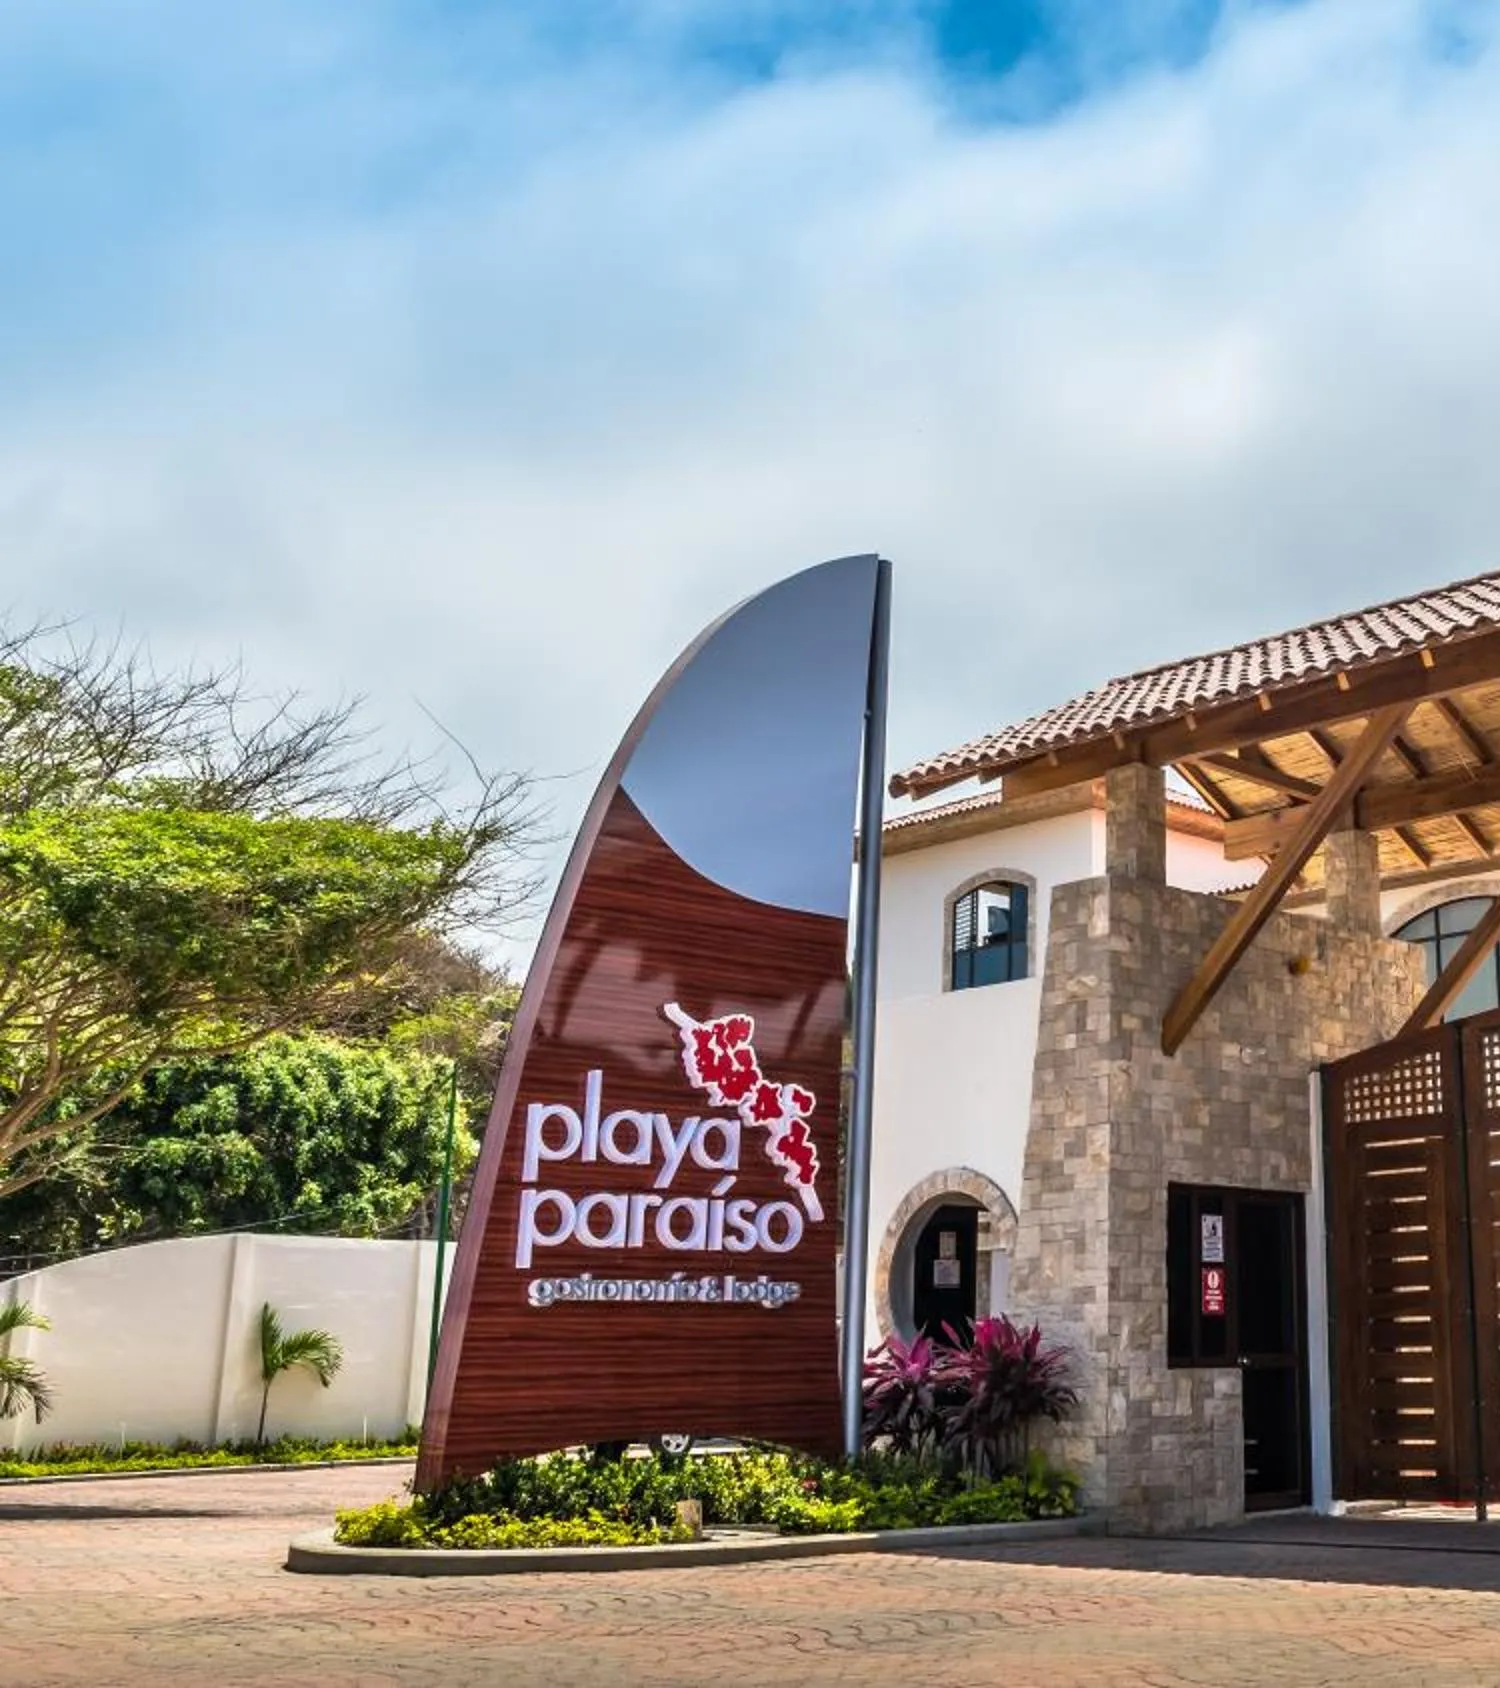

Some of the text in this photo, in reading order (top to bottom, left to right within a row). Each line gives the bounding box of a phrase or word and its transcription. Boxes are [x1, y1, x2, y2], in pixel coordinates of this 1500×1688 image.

[521, 1069, 741, 1188] playa
[515, 1175, 804, 1269] paraíso
[700, 1276, 721, 1302] &
[724, 1275, 801, 1308] lodge
